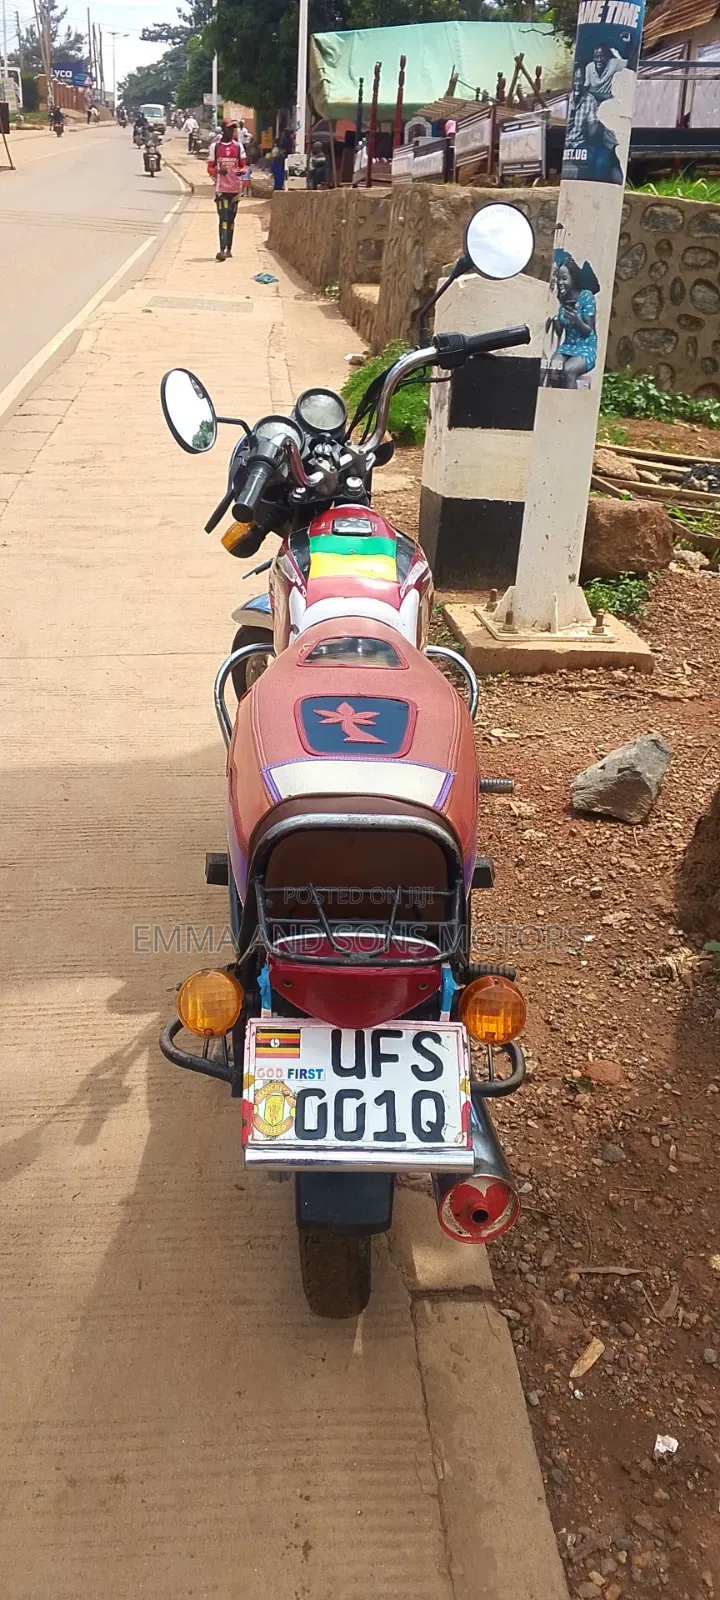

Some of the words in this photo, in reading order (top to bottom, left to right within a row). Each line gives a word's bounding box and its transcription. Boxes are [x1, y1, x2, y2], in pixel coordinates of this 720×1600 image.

[578, 0, 606, 25] AME
[605, 0, 641, 28] TIME
[331, 1029, 444, 1081] UFS
[257, 1067, 284, 1079] GOD
[287, 1068, 324, 1080] FIRST
[259, 1123, 287, 1134] UNITED
[294, 1088, 445, 1142] 001Q
